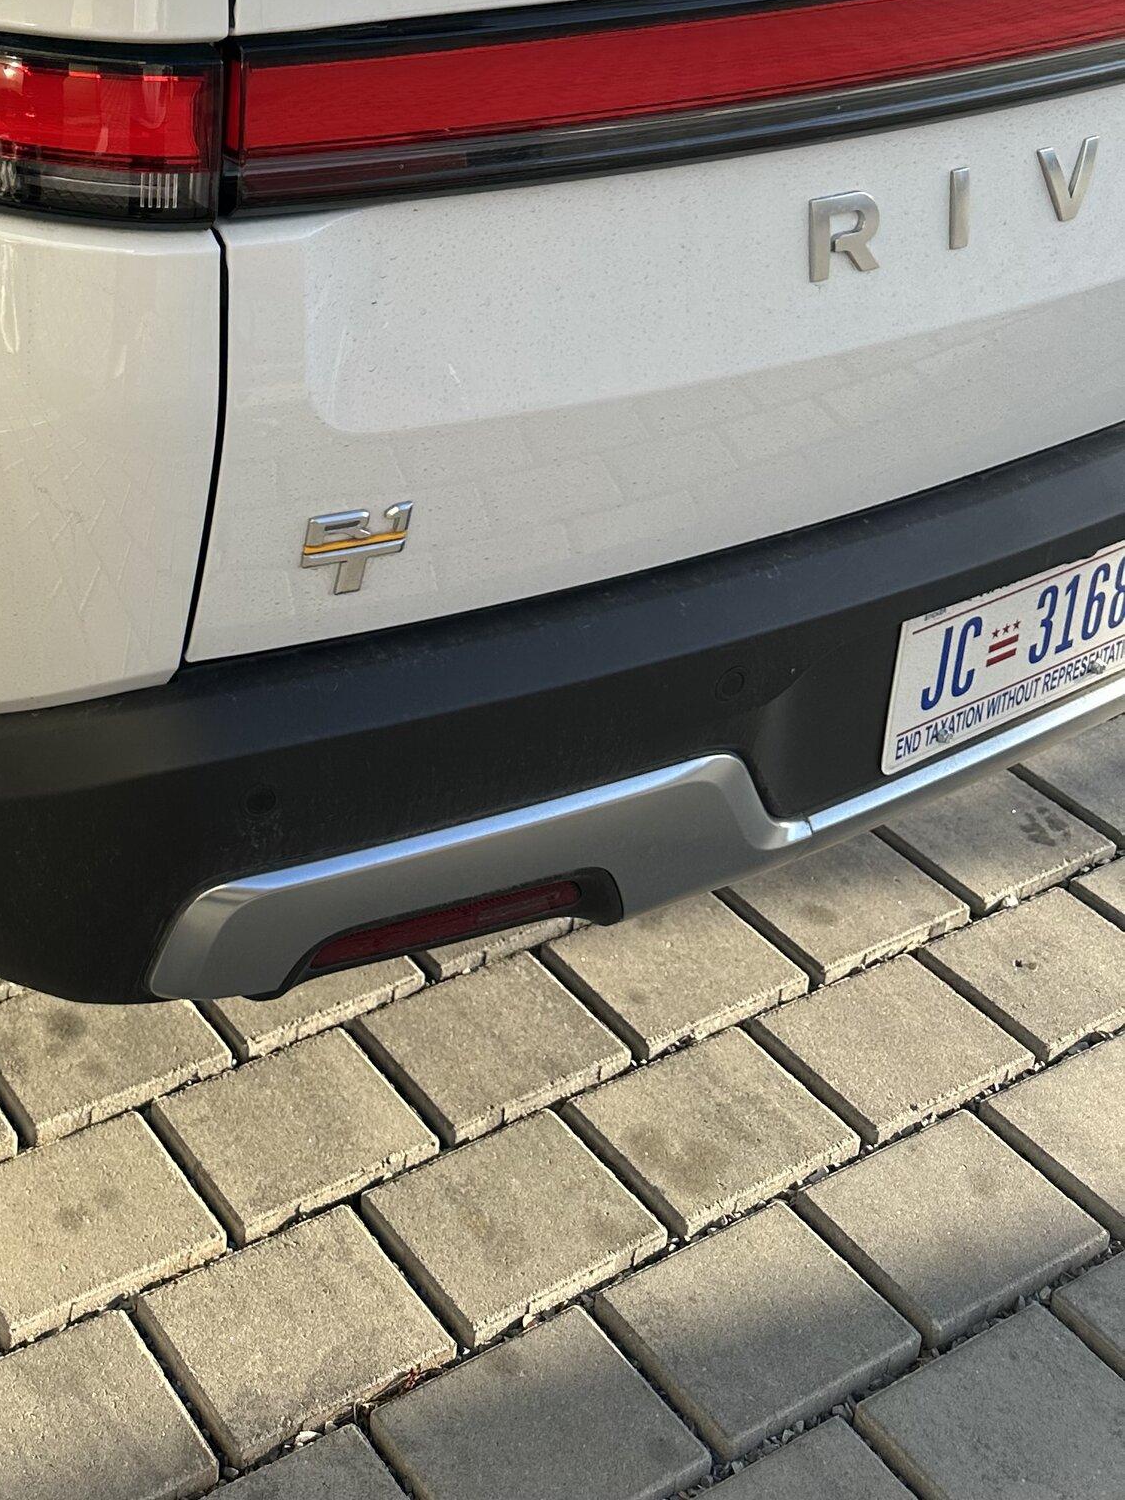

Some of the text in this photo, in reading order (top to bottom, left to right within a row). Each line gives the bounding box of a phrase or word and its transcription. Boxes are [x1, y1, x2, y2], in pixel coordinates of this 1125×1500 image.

[808, 134, 1100, 283] RIV
[920, 615, 983, 712] JC
[894, 731, 922, 761] END
[925, 702, 985, 746] TAXATION
[986, 676, 1042, 720] WITHOUT
